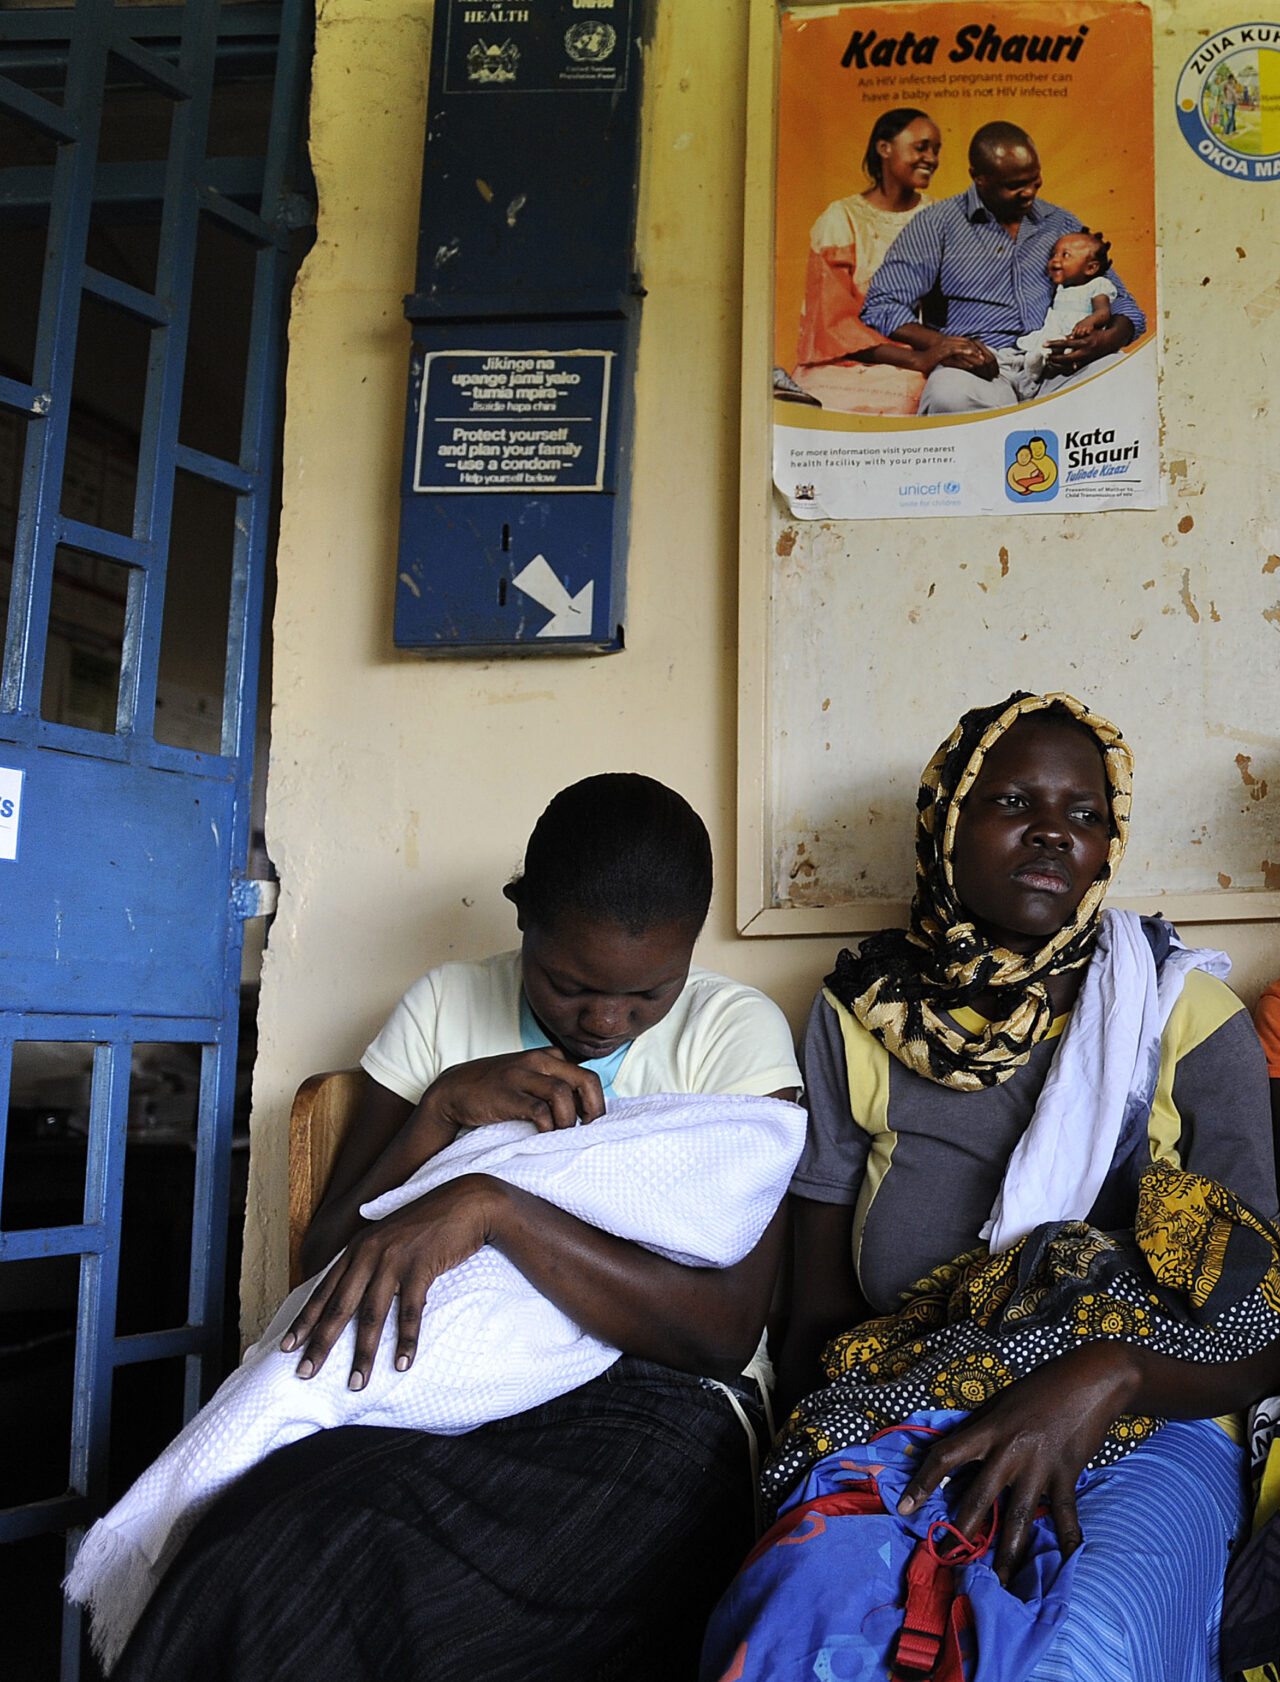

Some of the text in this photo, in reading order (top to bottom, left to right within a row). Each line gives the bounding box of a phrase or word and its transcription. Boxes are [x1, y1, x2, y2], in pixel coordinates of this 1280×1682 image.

[464, 10, 529, 23] HEALTH
[840, 23, 1090, 69] Kata Shauri
[1190, 36, 1235, 75] ZUIA
[858, 72, 1072, 87] An HIV infected pregnant mother can
[862, 92, 889, 102] have
[902, 89, 930, 101] baby
[933, 88, 959, 98] who
[962, 88, 971, 97] is
[974, 88, 993, 97] not
[997, 87, 1017, 97] HIV
[1020, 86, 1067, 96] infected
[1198, 139, 1249, 176] OKOA
[482, 357, 555, 371] Jikinge na
[452, 372, 581, 386] upange jamii yako
[507, 402, 531, 412] hapa
[533, 401, 557, 411] chini
[453, 428, 568, 443] Protect yourself
[1065, 427, 1115, 449] Kata
[438, 443, 582, 458] and plan your family
[830, 448, 880, 456] information
[1068, 440, 1139, 468] Shauri
[487, 460, 498, 470] a
[825, 459, 860, 467] facility
[915, 457, 956, 465] partner.
[1099, 461, 1131, 477] Kizazi
[460, 472, 557, 484] Help yourself below
[898, 481, 941, 496] unicef
